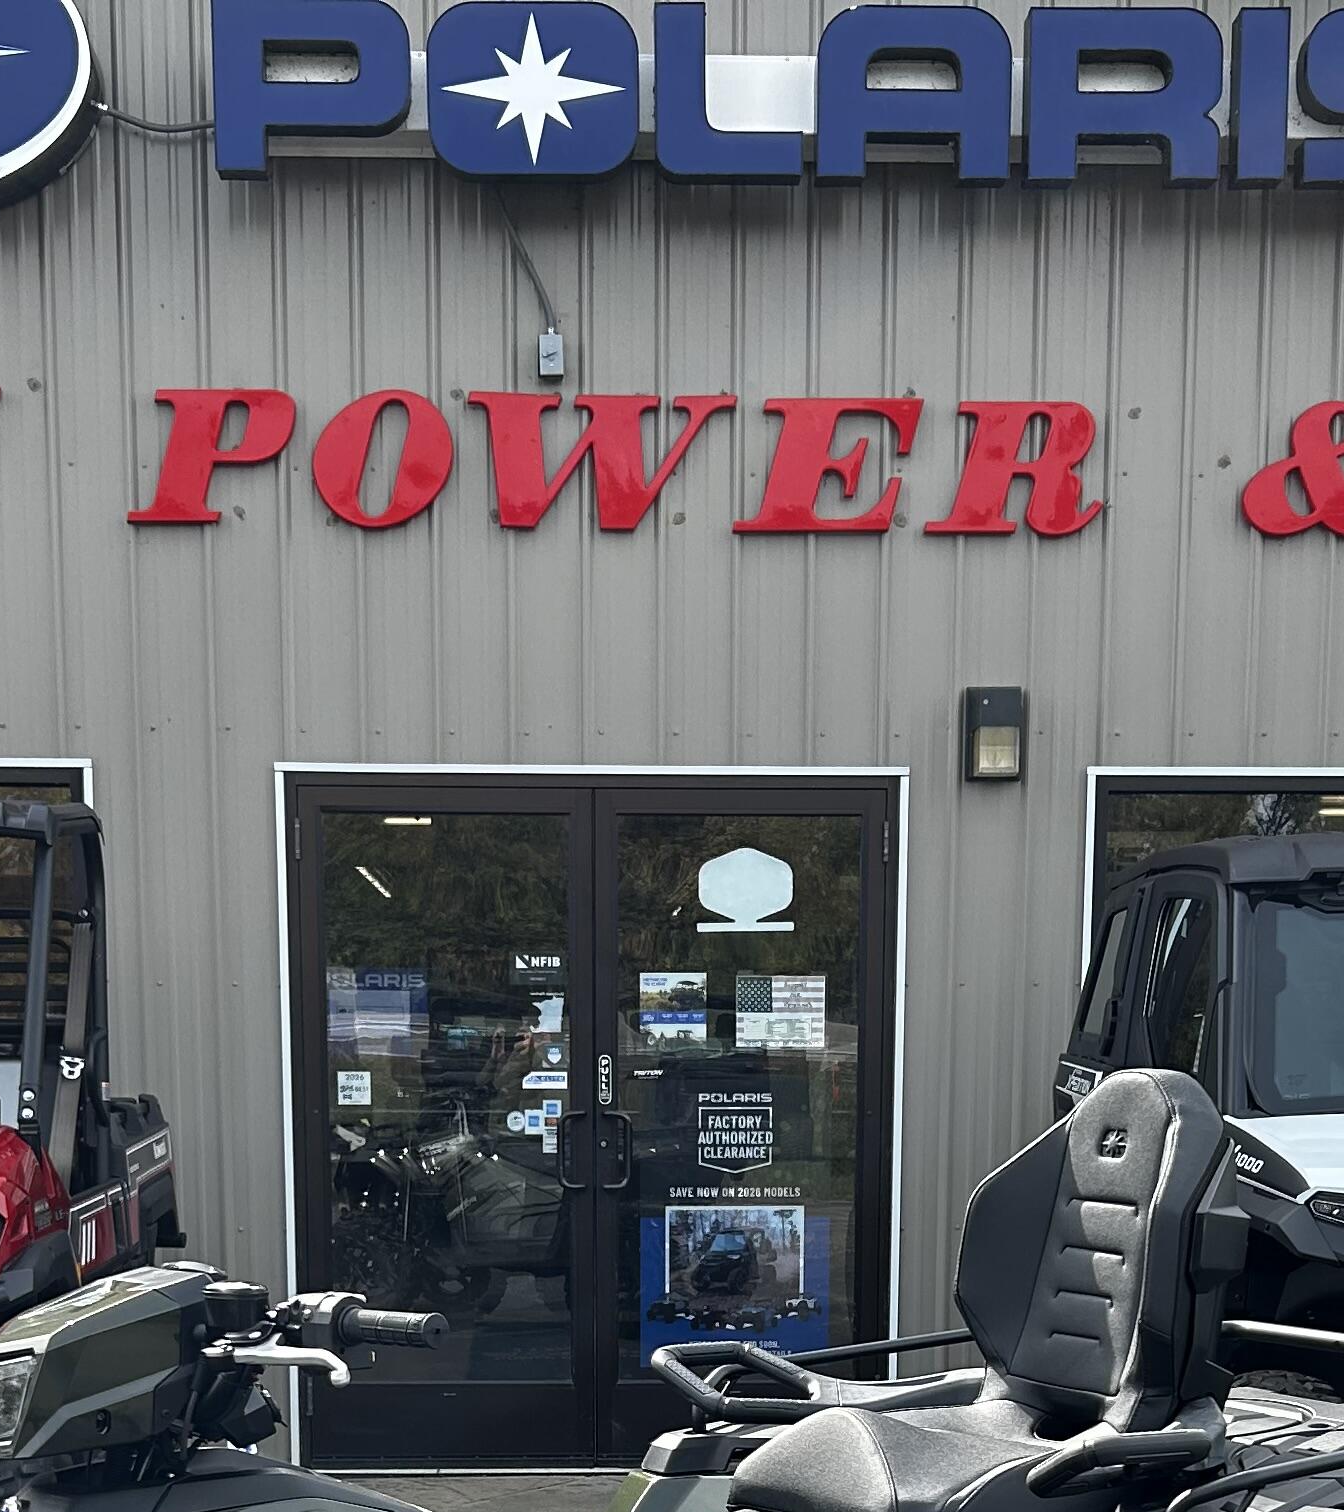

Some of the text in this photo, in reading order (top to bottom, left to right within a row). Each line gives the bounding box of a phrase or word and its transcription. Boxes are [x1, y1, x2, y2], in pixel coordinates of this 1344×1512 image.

[127, 387, 1102, 536] POWER
[531, 956, 561, 968] NFIB
[600, 1058, 610, 1091] PULL
[698, 1093, 773, 1103] POLARIS
[708, 1115, 763, 1129] FACTORY
[697, 1131, 774, 1145] AUTHORIZED
[703, 1146, 767, 1159] CLEARANCE
[669, 1187, 694, 1198] SAVE
[696, 1187, 719, 1198] NOW
[722, 1187, 735, 1198] ON
[763, 1187, 801, 1198] MODELS
